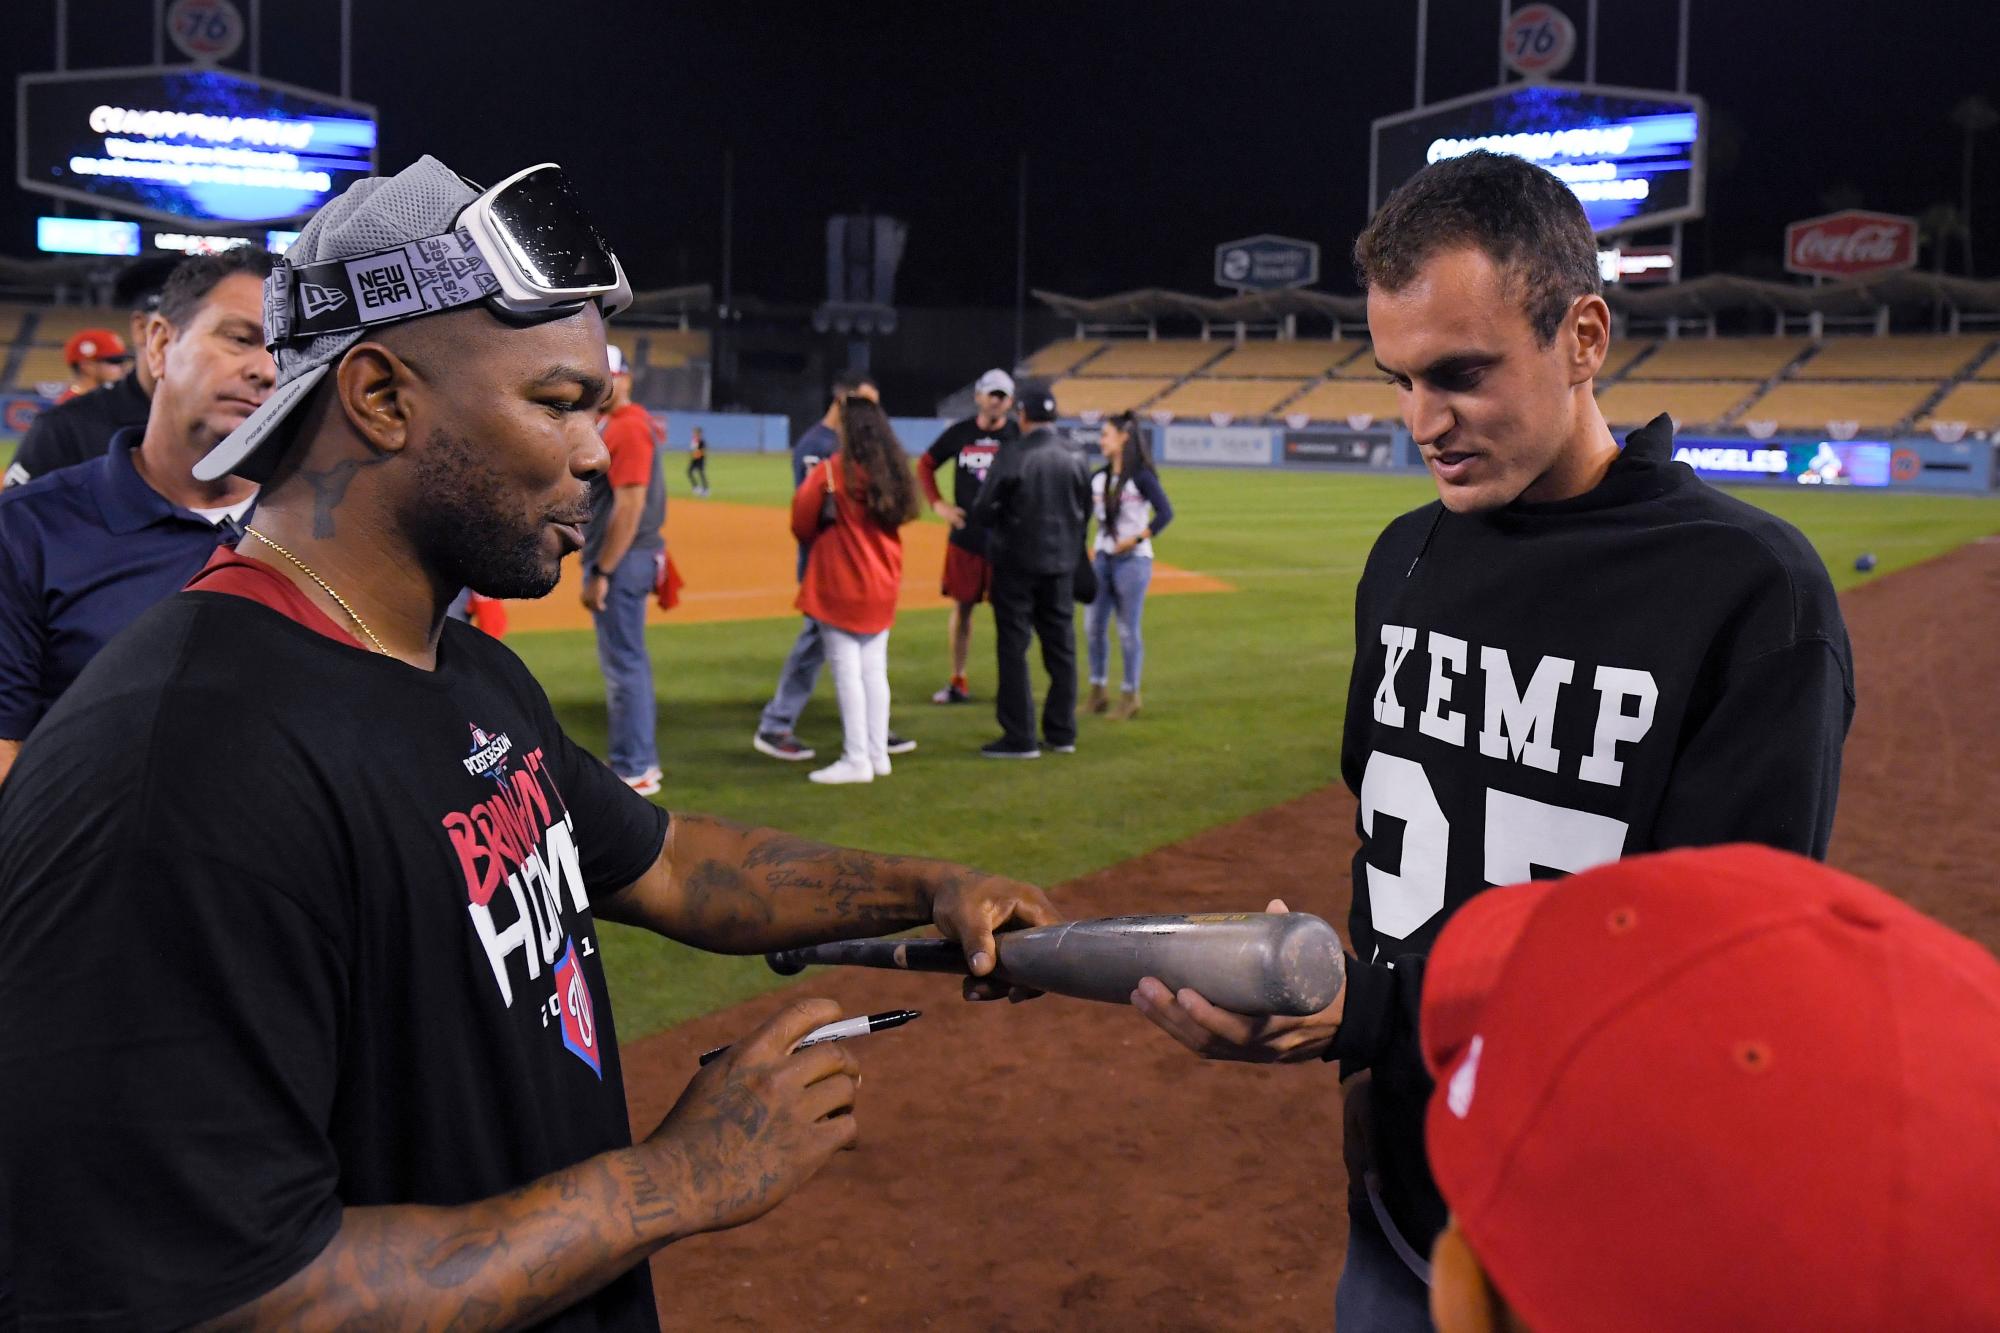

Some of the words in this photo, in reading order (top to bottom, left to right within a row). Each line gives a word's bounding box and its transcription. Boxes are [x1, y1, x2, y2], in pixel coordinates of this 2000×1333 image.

[1516, 19, 1555, 55] 76
[356, 263, 406, 291] NEW
[362, 282, 412, 309] ERA
[245, 383, 301, 446] POSTSEASON
[1373, 623, 1659, 787] KEMP
[462, 731, 513, 776] POSTSESON
[467, 810, 590, 1009] HOM
